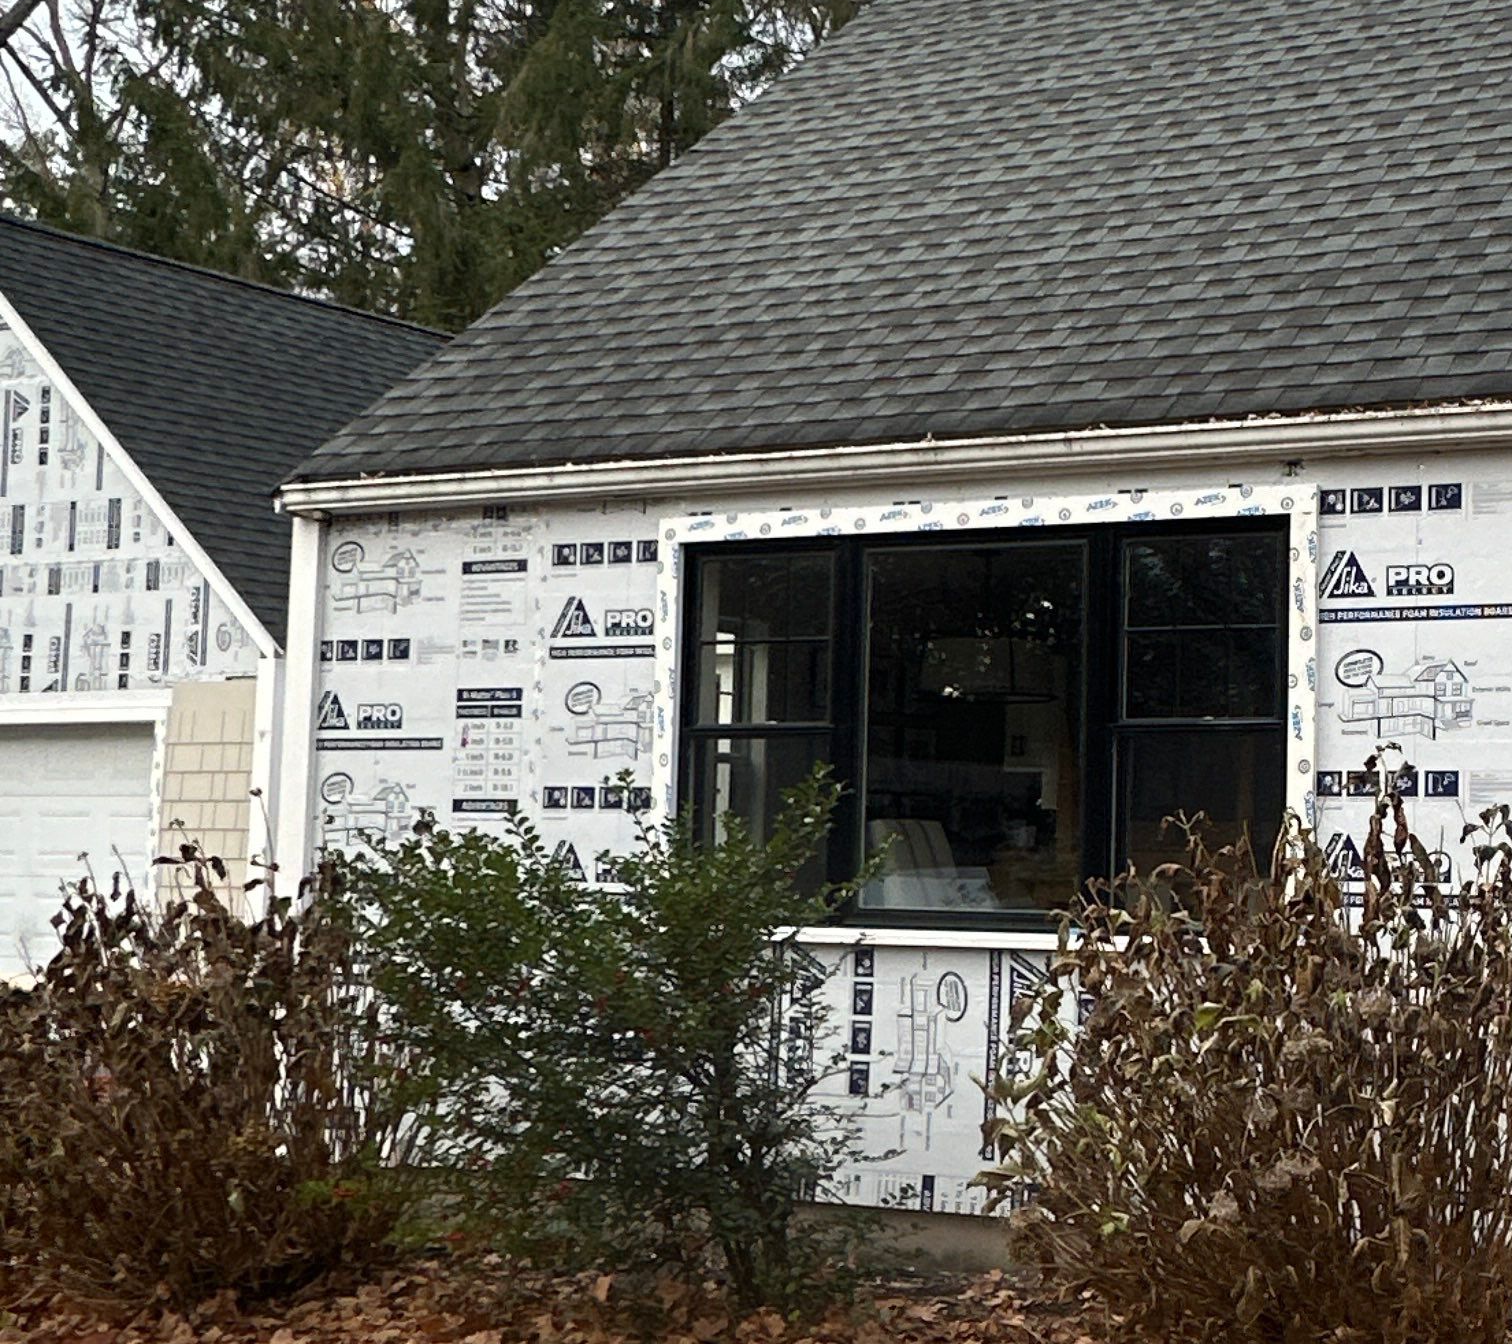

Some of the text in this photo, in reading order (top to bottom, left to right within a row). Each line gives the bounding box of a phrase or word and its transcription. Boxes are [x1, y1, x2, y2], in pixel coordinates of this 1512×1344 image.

[1334, 565, 1368, 595] Sika
[1388, 565, 1453, 587] PRO
[606, 610, 653, 627] PRO
[359, 706, 401, 722] PRO
